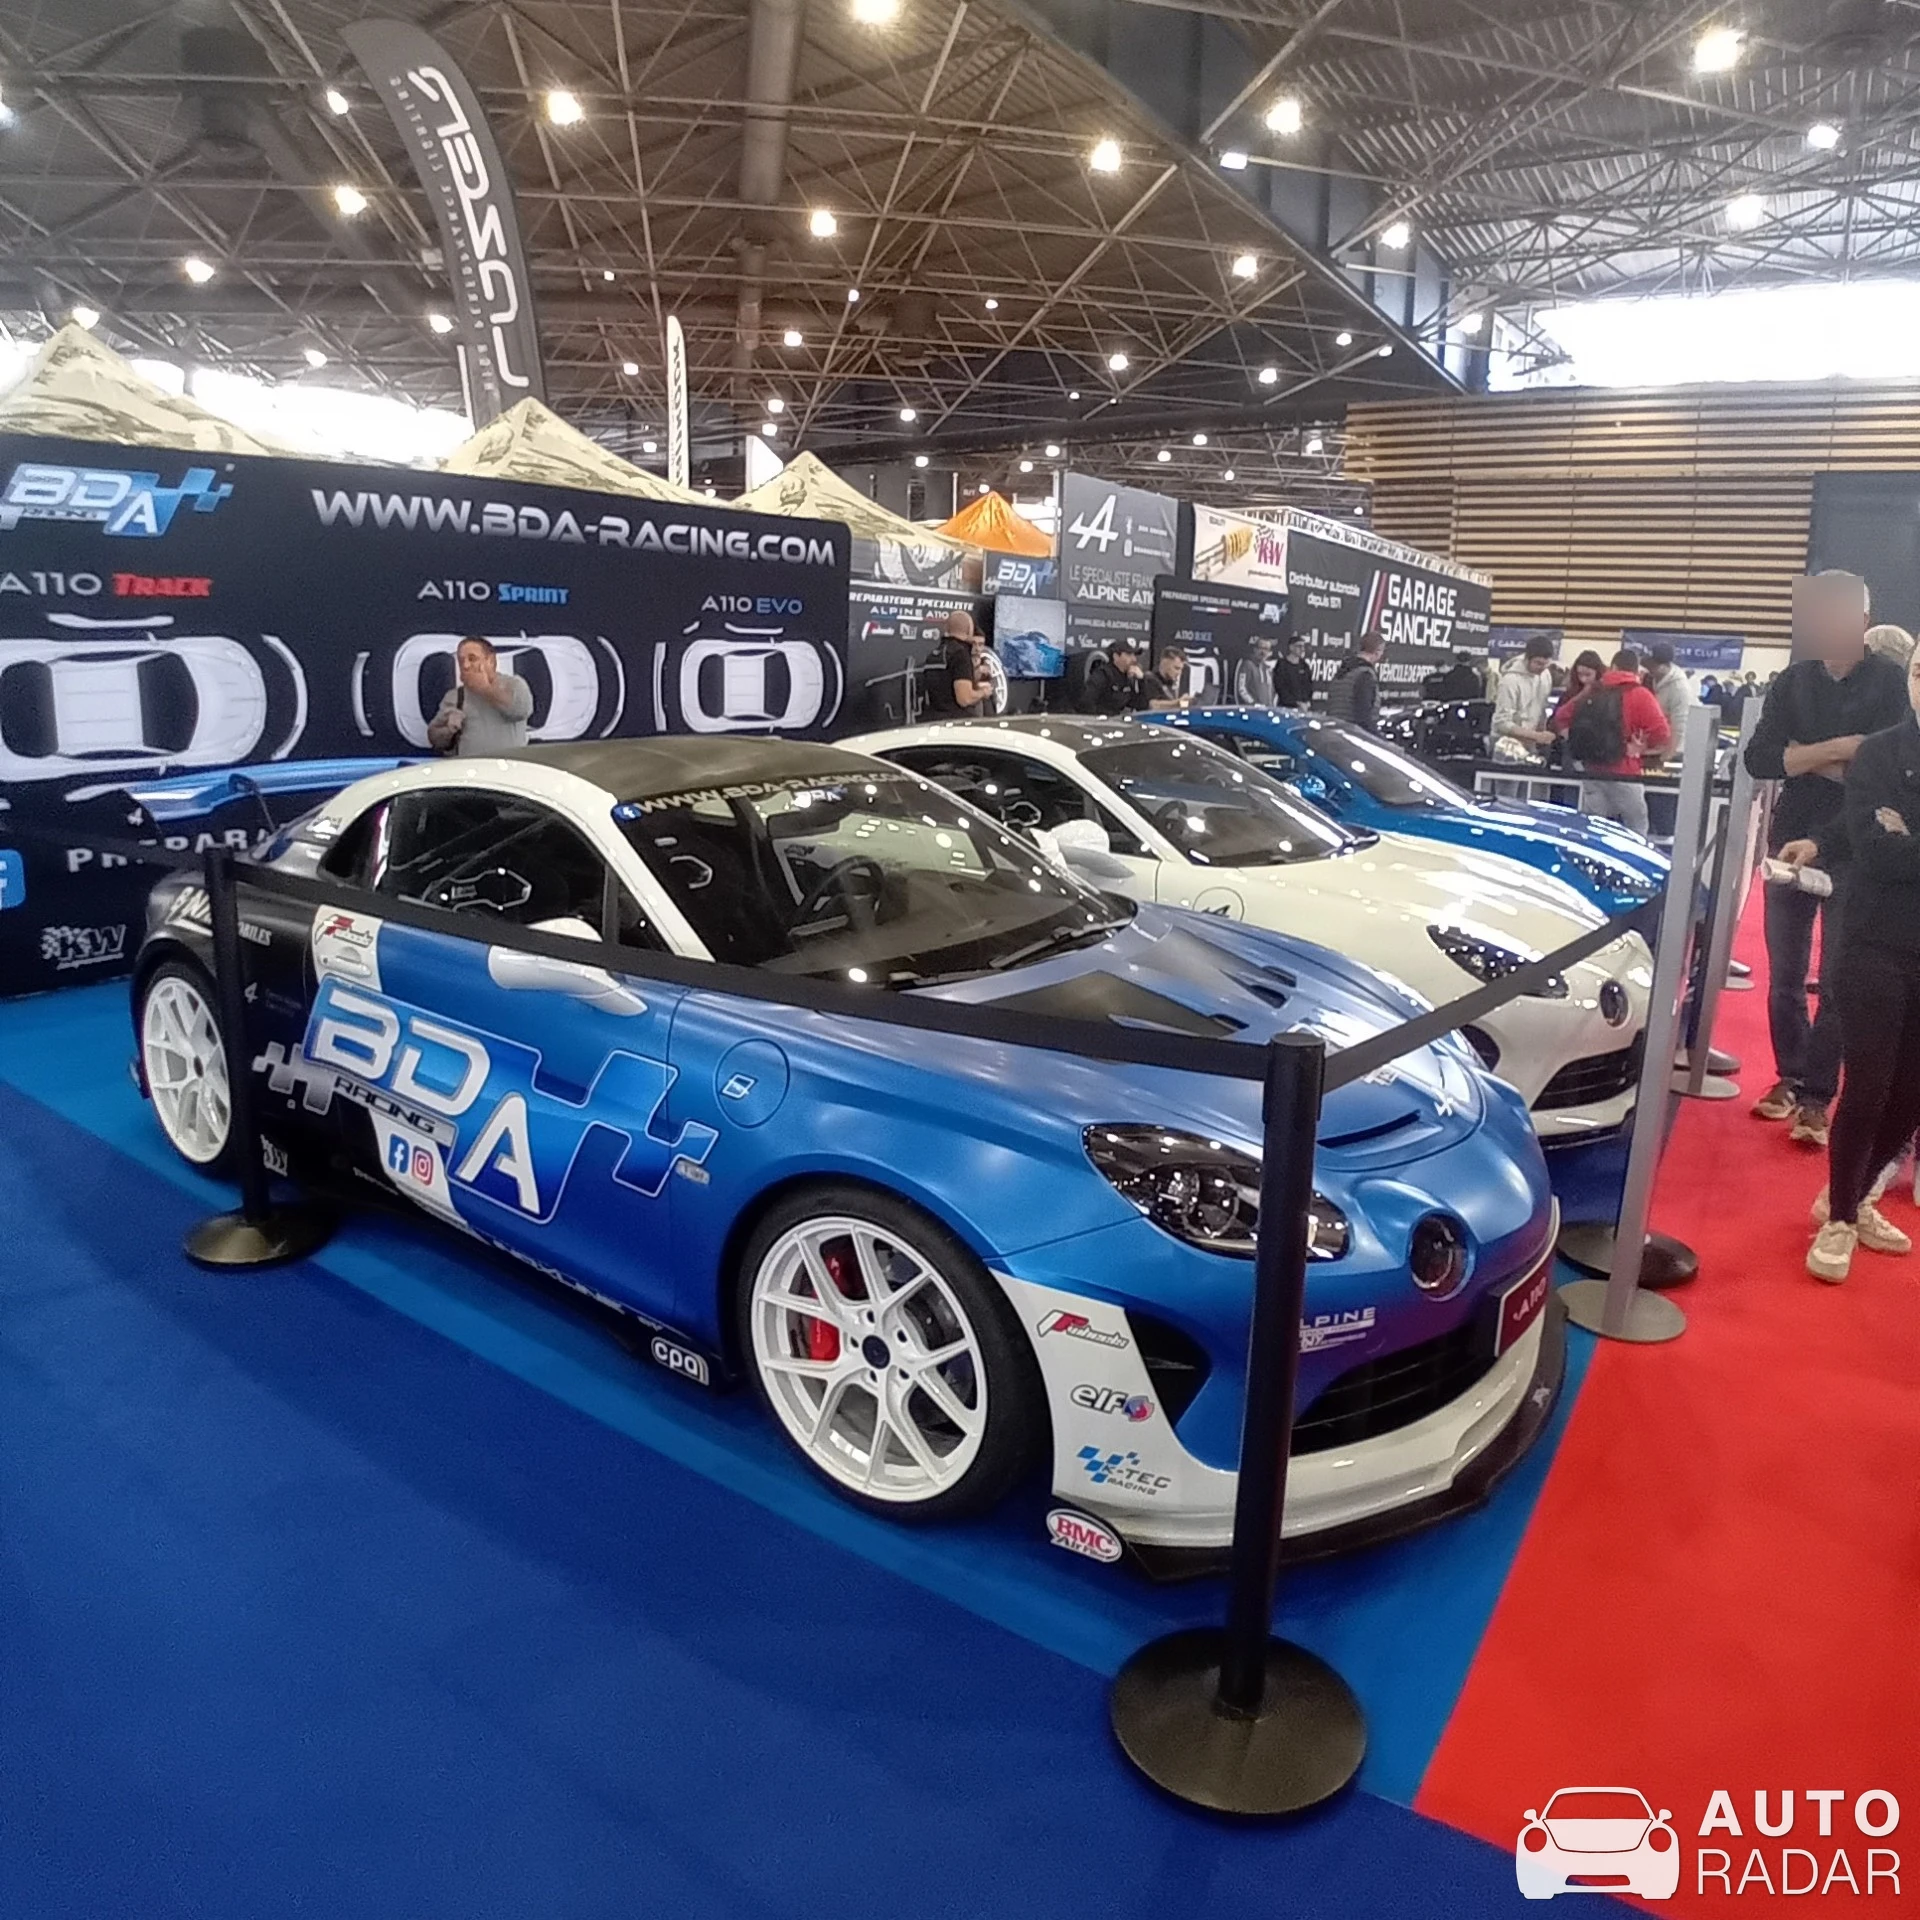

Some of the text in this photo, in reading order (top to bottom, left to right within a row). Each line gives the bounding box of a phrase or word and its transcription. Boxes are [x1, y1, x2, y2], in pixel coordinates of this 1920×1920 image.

[9, 468, 159, 534] BDA
[311, 489, 835, 567] WWW.BDA-RACING.COM
[0, 572, 102, 596] A110
[417, 580, 490, 600] A110
[997, 560, 1036, 595] BDA
[1077, 583, 1130, 603] ALPINE
[701, 595, 803, 615] A110 EVO
[1388, 573, 1457, 618] GARAGE
[870, 606, 949, 620] ALPINE A110
[1380, 608, 1452, 648] SANCHEZ
[313, 986, 540, 1214] BDA
[332, 1076, 437, 1135] RACING
[1071, 1384, 1127, 1414] elf
[1106, 1477, 1157, 1496] RACING
[1056, 1517, 1113, 1548] BMC
